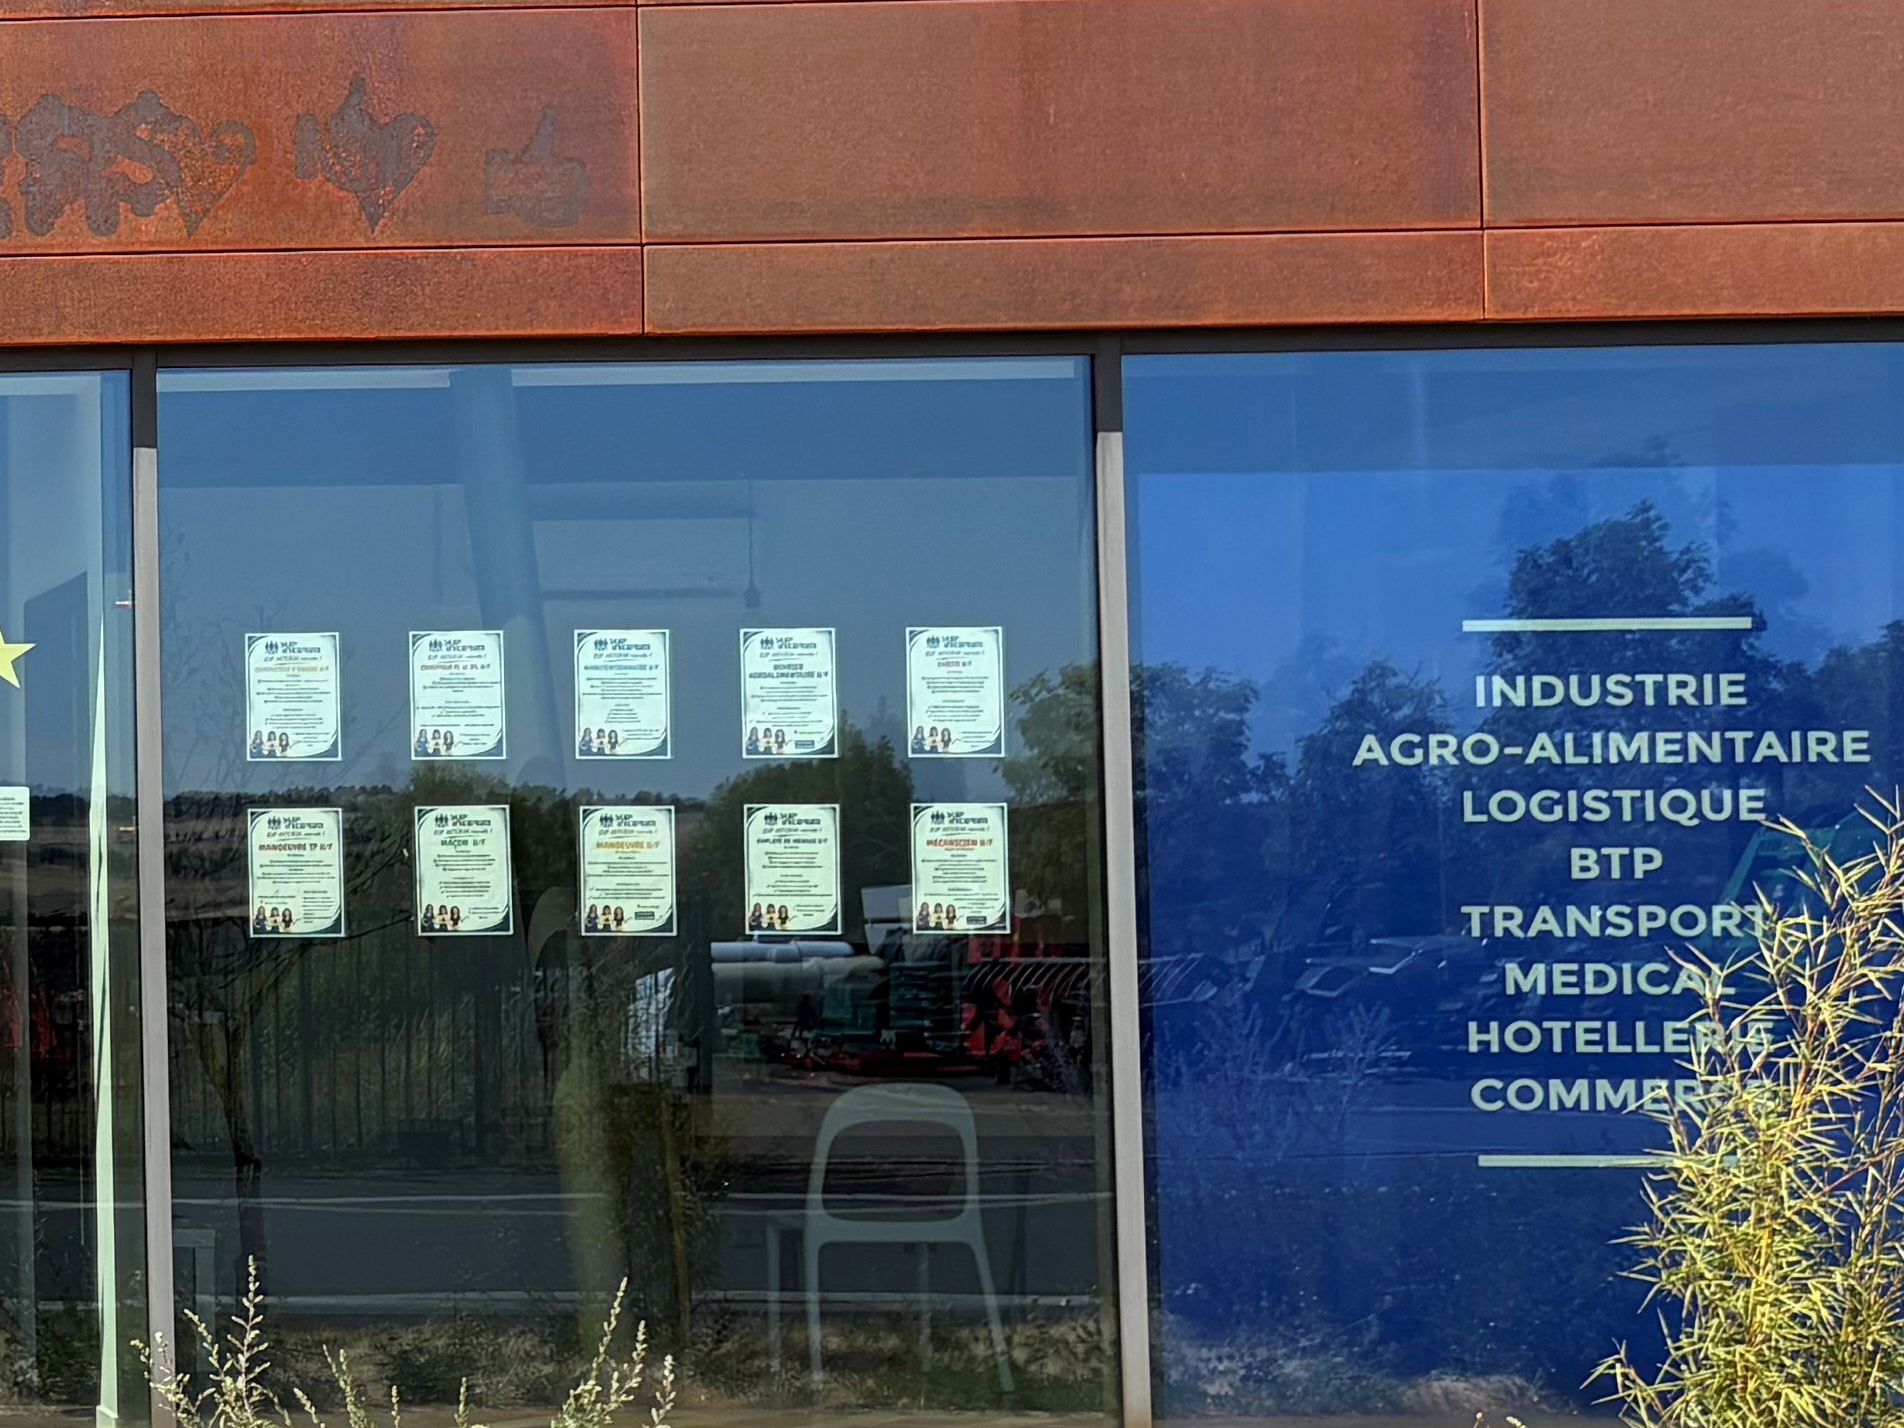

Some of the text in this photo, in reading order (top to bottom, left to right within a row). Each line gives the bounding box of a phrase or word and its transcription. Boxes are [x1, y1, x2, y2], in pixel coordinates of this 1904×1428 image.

[1475, 673, 1748, 708] INDUSTRIE
[1352, 729, 1872, 766] AGRO-ALIMENTAIRE
[1462, 788, 1767, 826] LOGISTIQUE
[1570, 847, 1664, 880] BTP
[1460, 904, 1767, 938] TRANSPORT
[1505, 962, 1737, 996] MEDICAL
